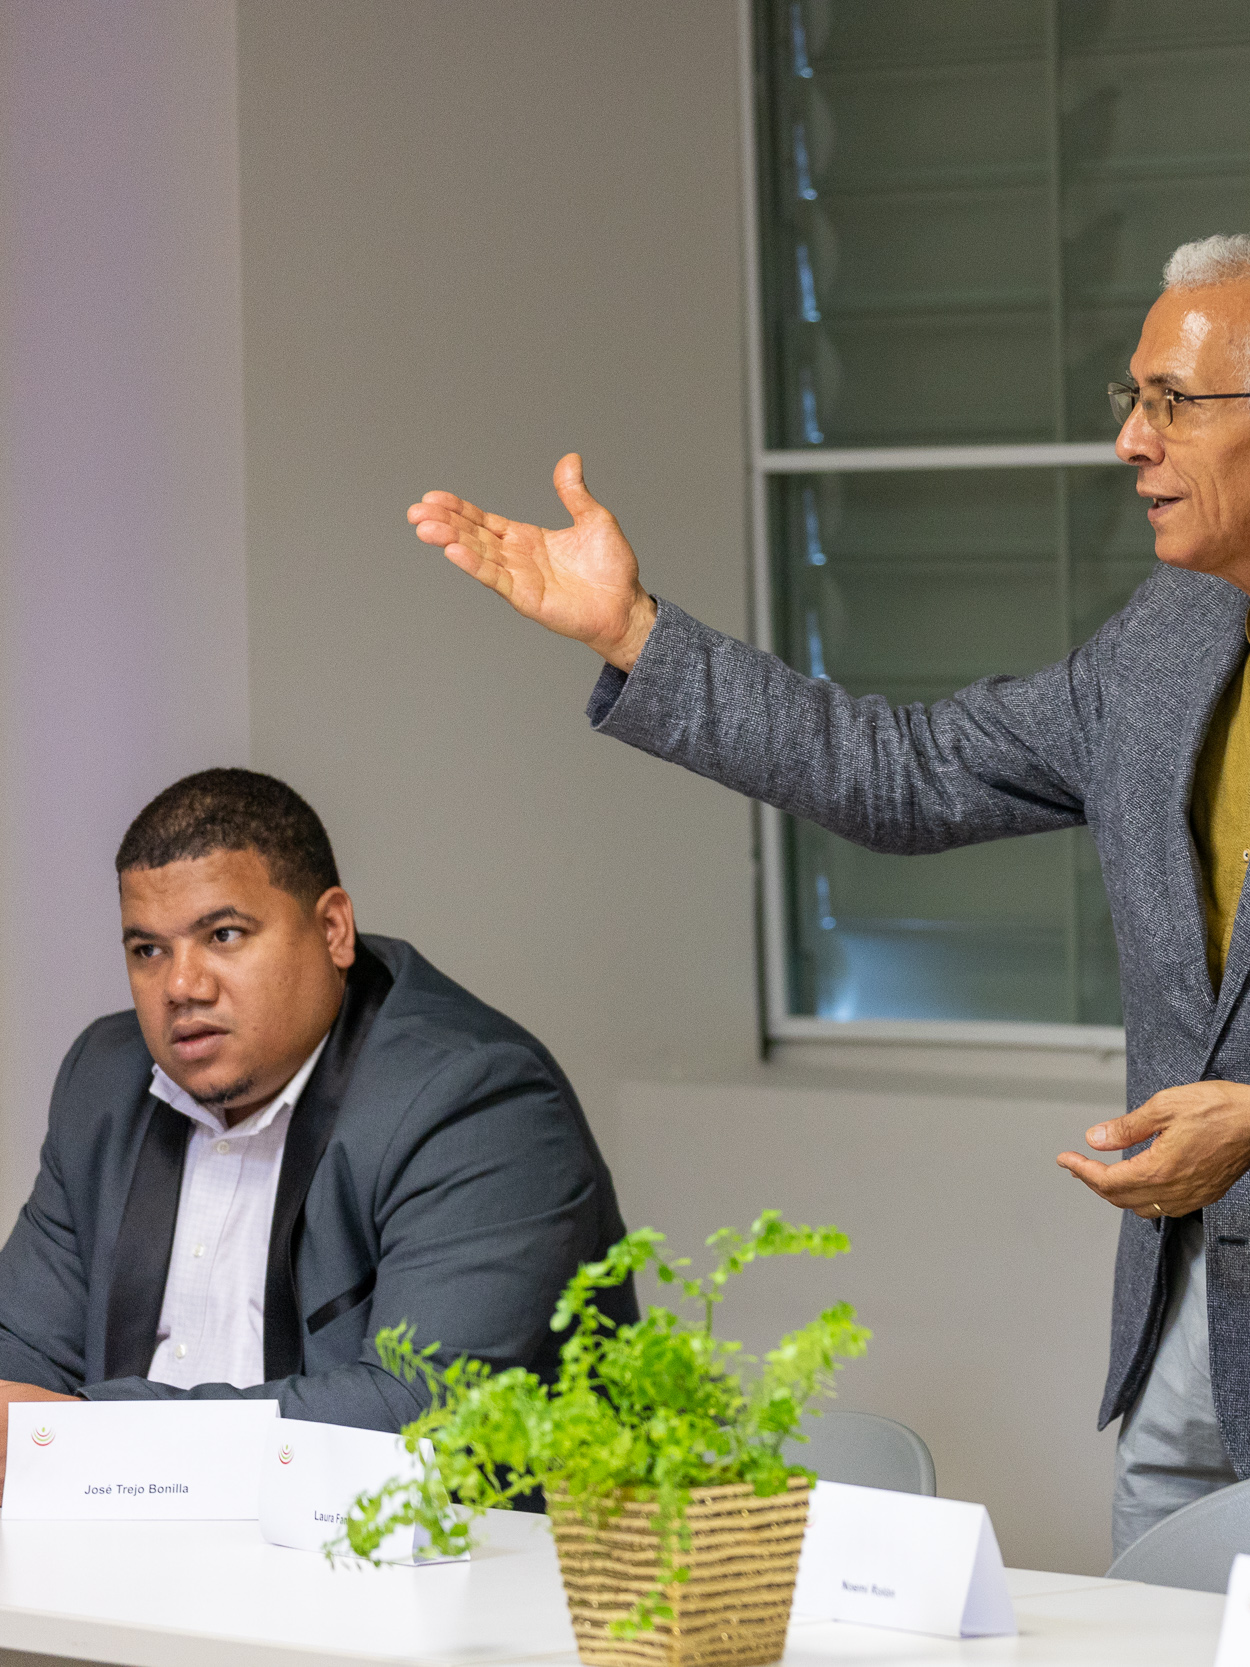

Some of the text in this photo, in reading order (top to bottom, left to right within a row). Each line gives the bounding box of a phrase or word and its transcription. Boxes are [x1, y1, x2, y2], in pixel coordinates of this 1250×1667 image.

[84, 1483, 189, 1497] José Trejo Bonilla
[314, 1510, 349, 1525] Laura Fan
